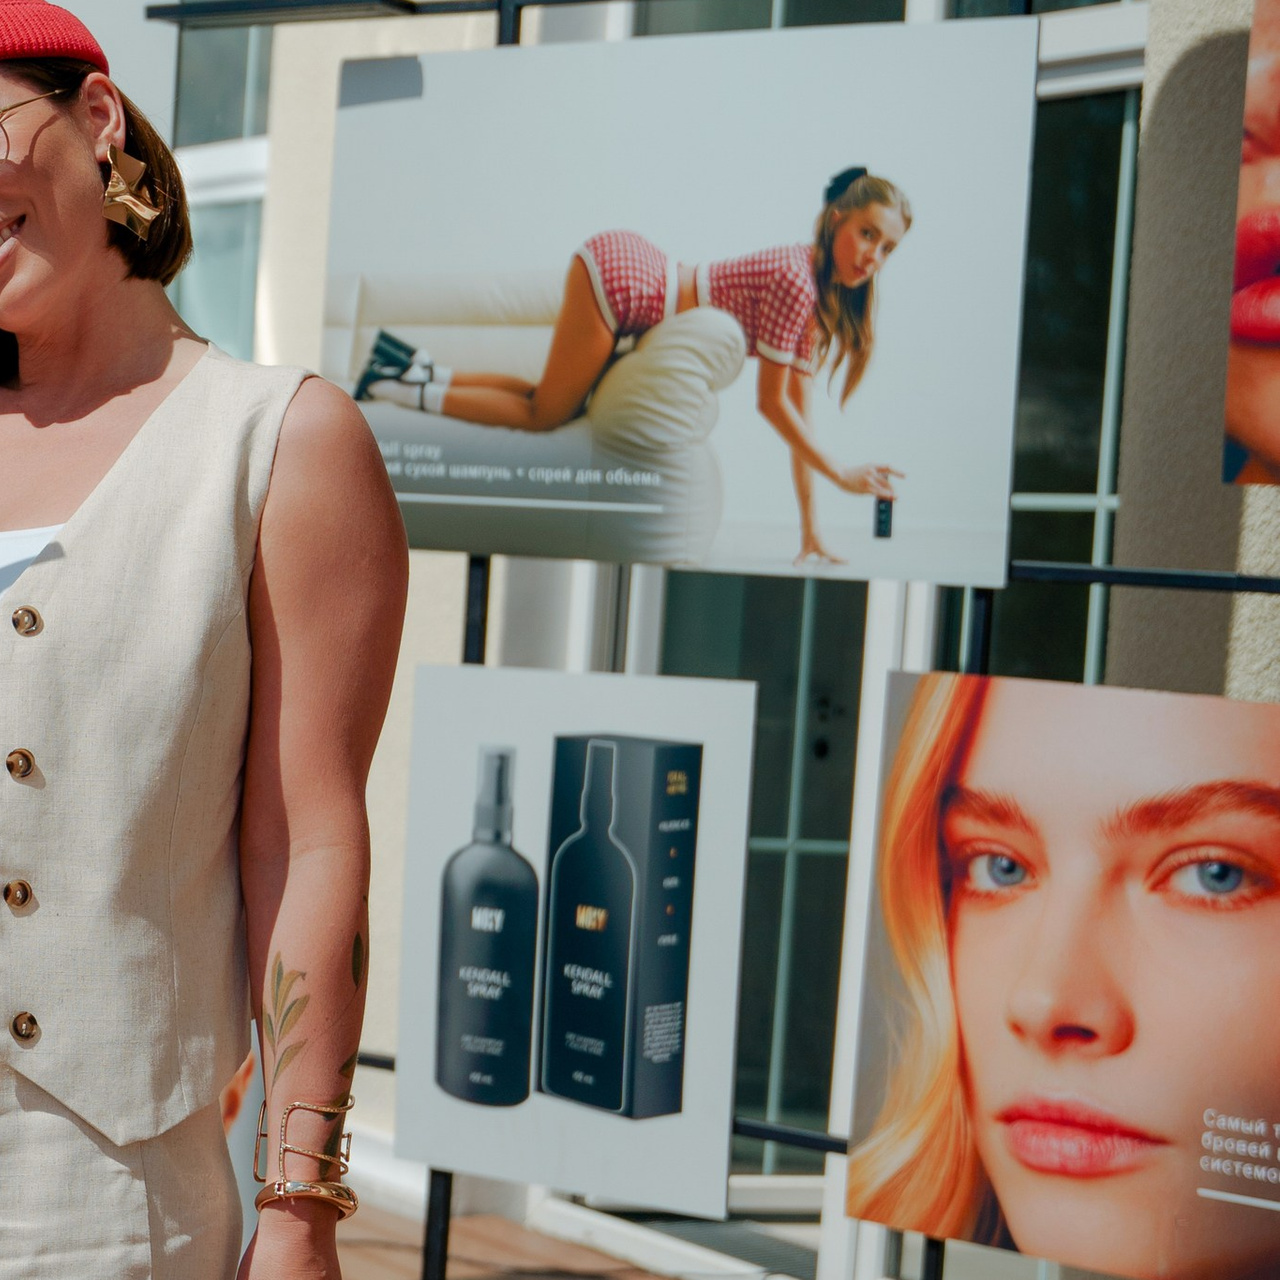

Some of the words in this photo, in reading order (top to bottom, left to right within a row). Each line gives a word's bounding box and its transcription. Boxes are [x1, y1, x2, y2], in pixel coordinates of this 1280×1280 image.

[403, 443, 442, 461] spray
[404, 462, 446, 481] сухой
[449, 464, 511, 482] шампунь
[528, 466, 571, 484] спрей
[575, 469, 602, 485] для
[1203, 1108, 1268, 1137] Самый
[1201, 1130, 1273, 1160] бровей
[1199, 1155, 1280, 1184] системо
